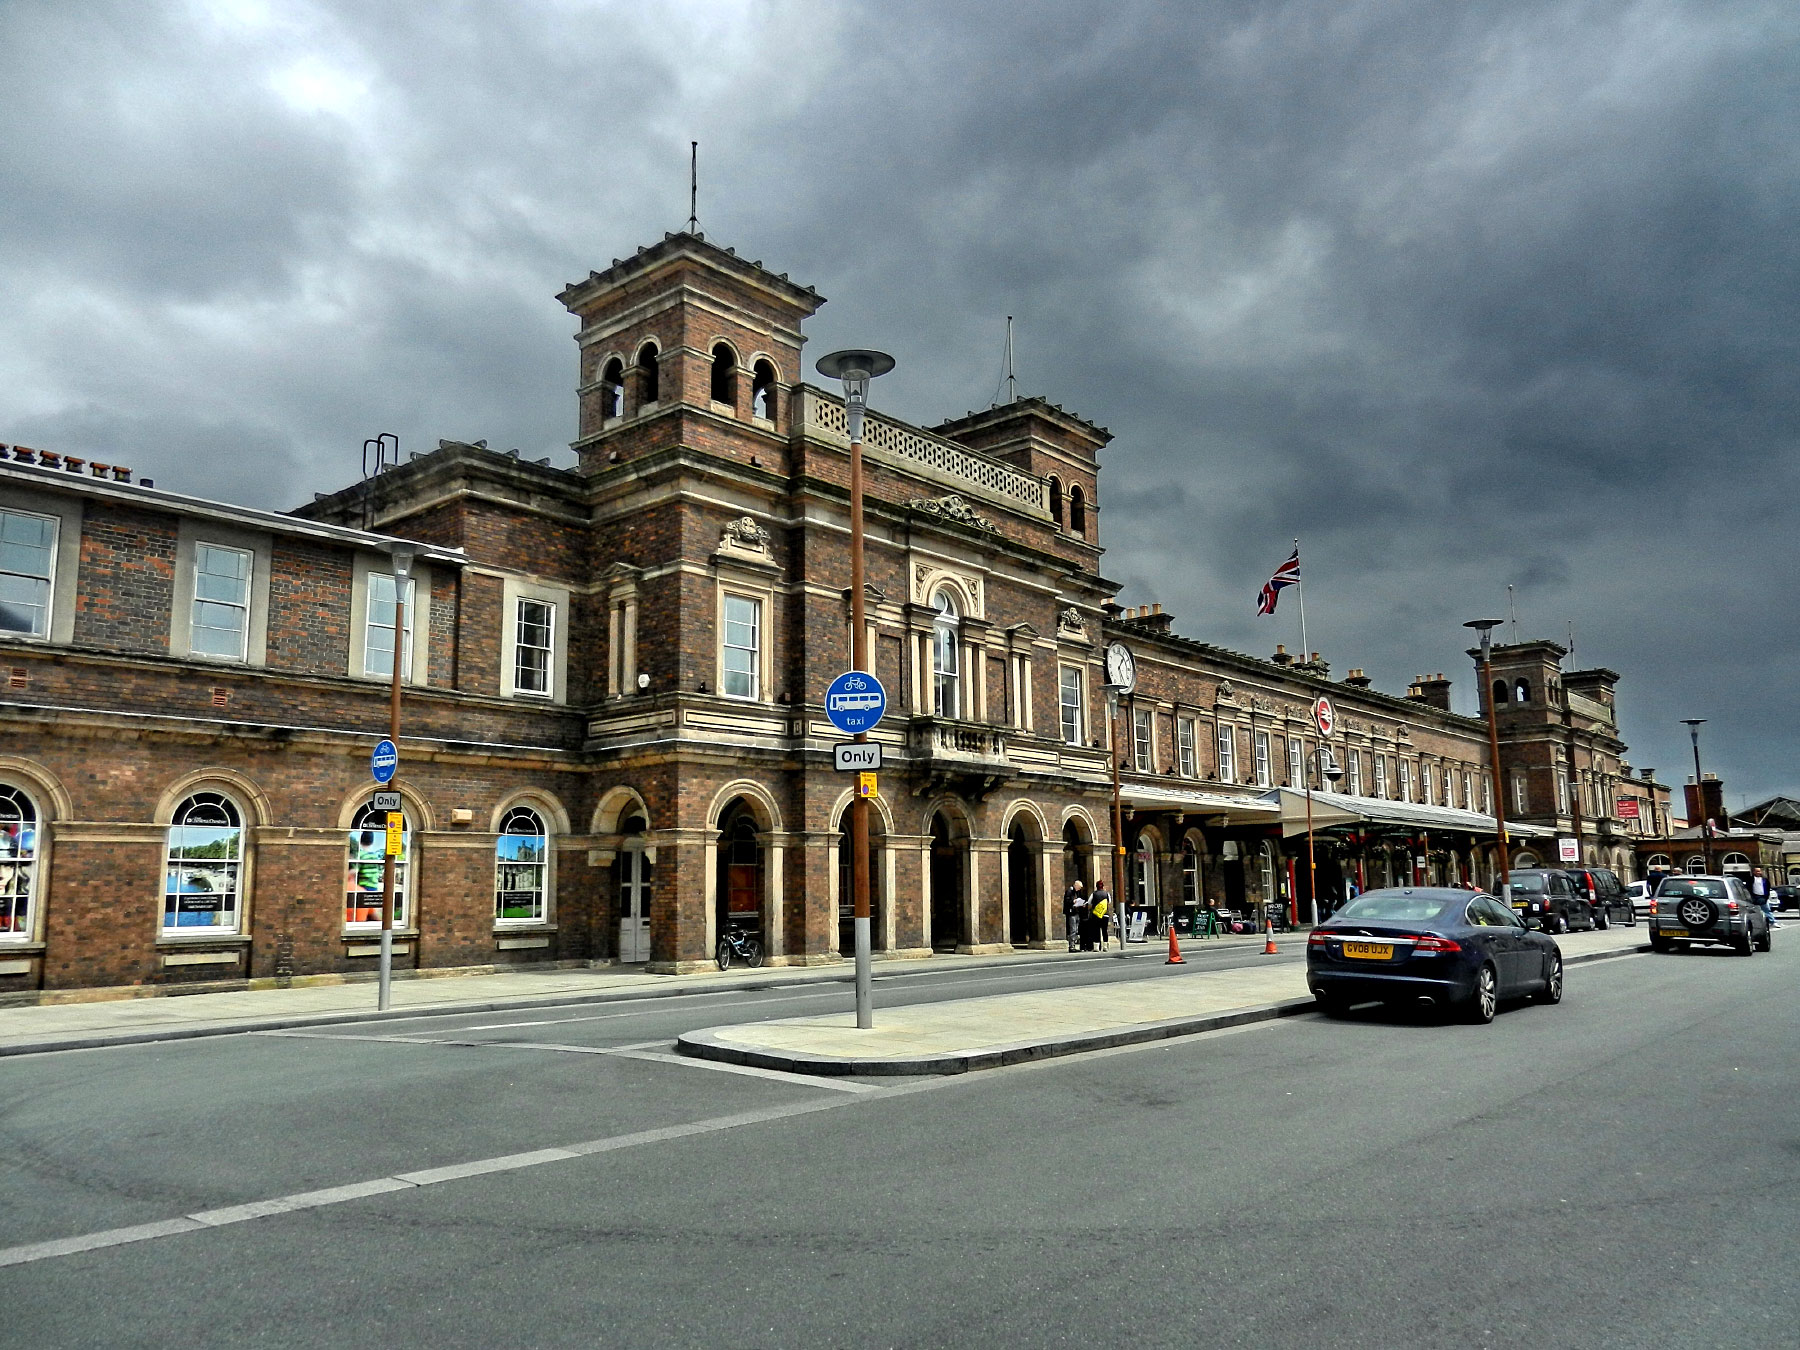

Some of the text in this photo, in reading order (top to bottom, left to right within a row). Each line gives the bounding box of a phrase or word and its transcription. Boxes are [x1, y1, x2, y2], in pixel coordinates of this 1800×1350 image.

[847, 717, 865, 726] taxi
[841, 750, 875, 764] Only
[377, 796, 398, 807] Only
[1347, 944, 1389, 955] GV08 UJX
